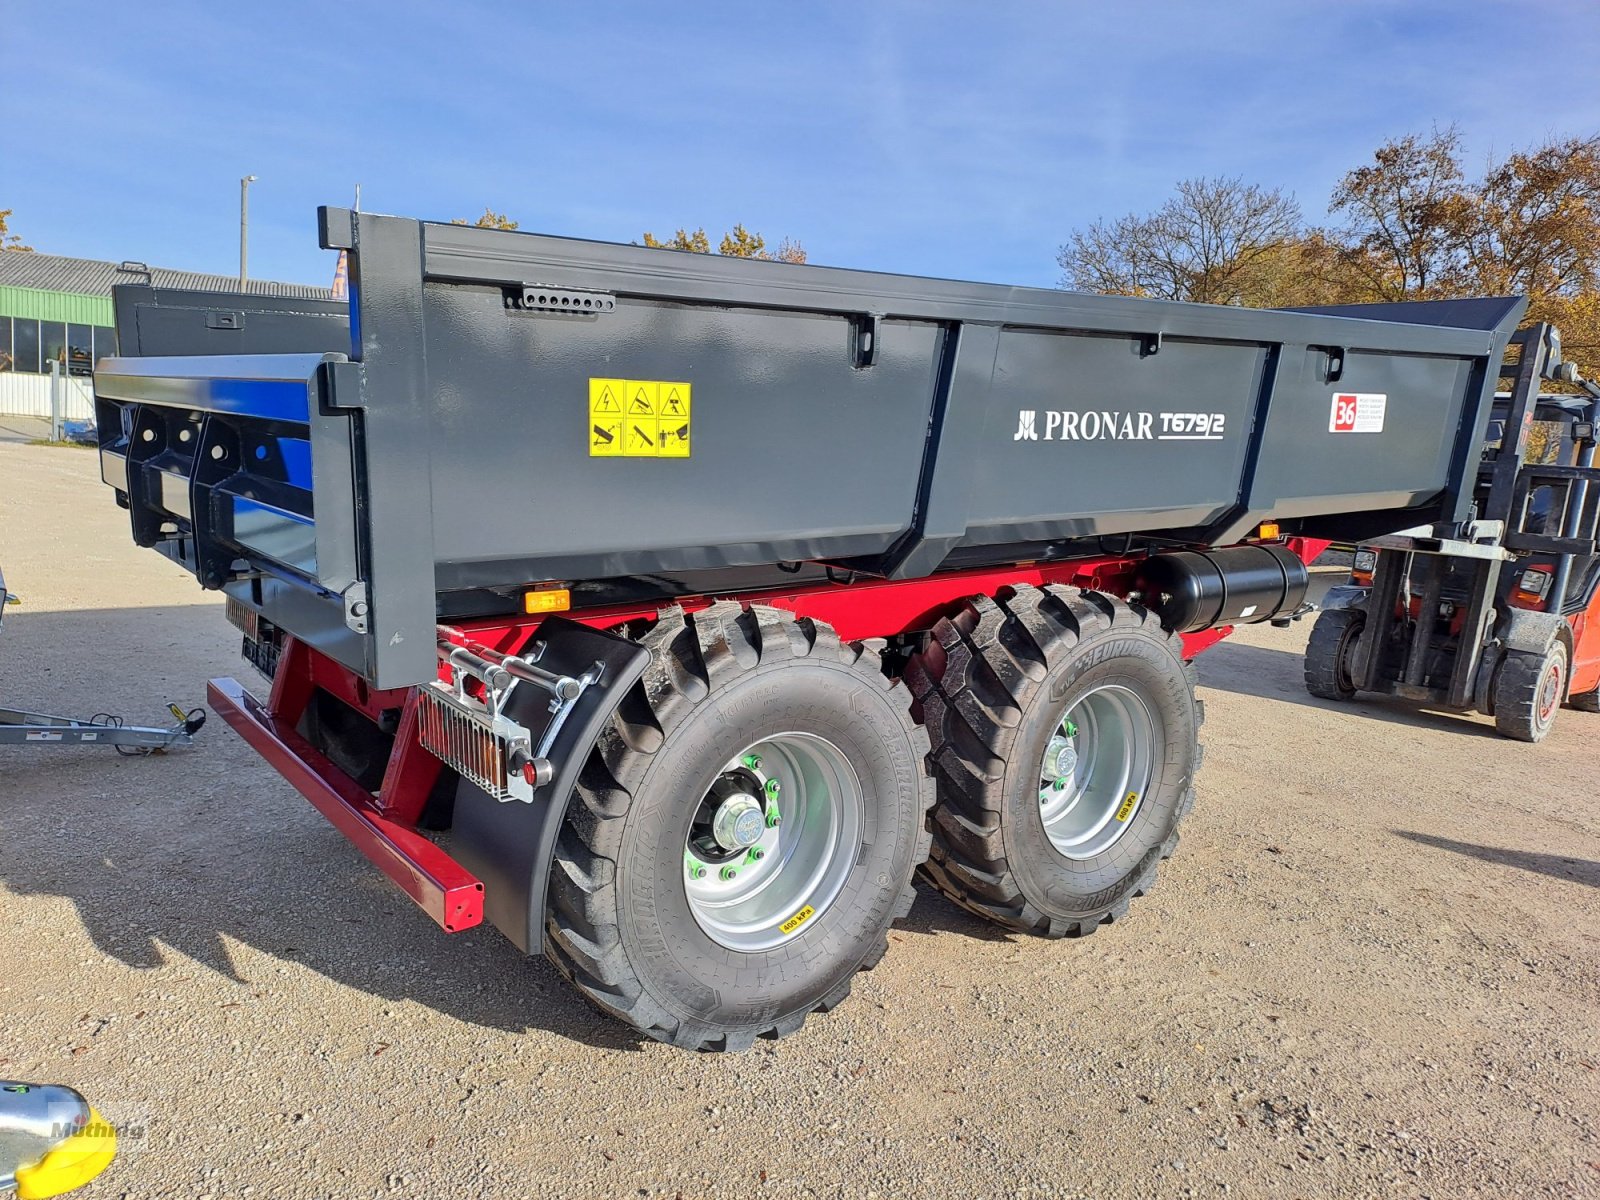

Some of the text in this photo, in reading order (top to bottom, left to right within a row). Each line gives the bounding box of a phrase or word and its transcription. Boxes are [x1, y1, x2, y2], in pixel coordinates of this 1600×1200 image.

[1336, 401, 1355, 425] 36
[1043, 411, 1225, 441] PRONAR T679/2
[1118, 795, 1136, 819] 400 kPa
[783, 908, 812, 931] 400 kPa
